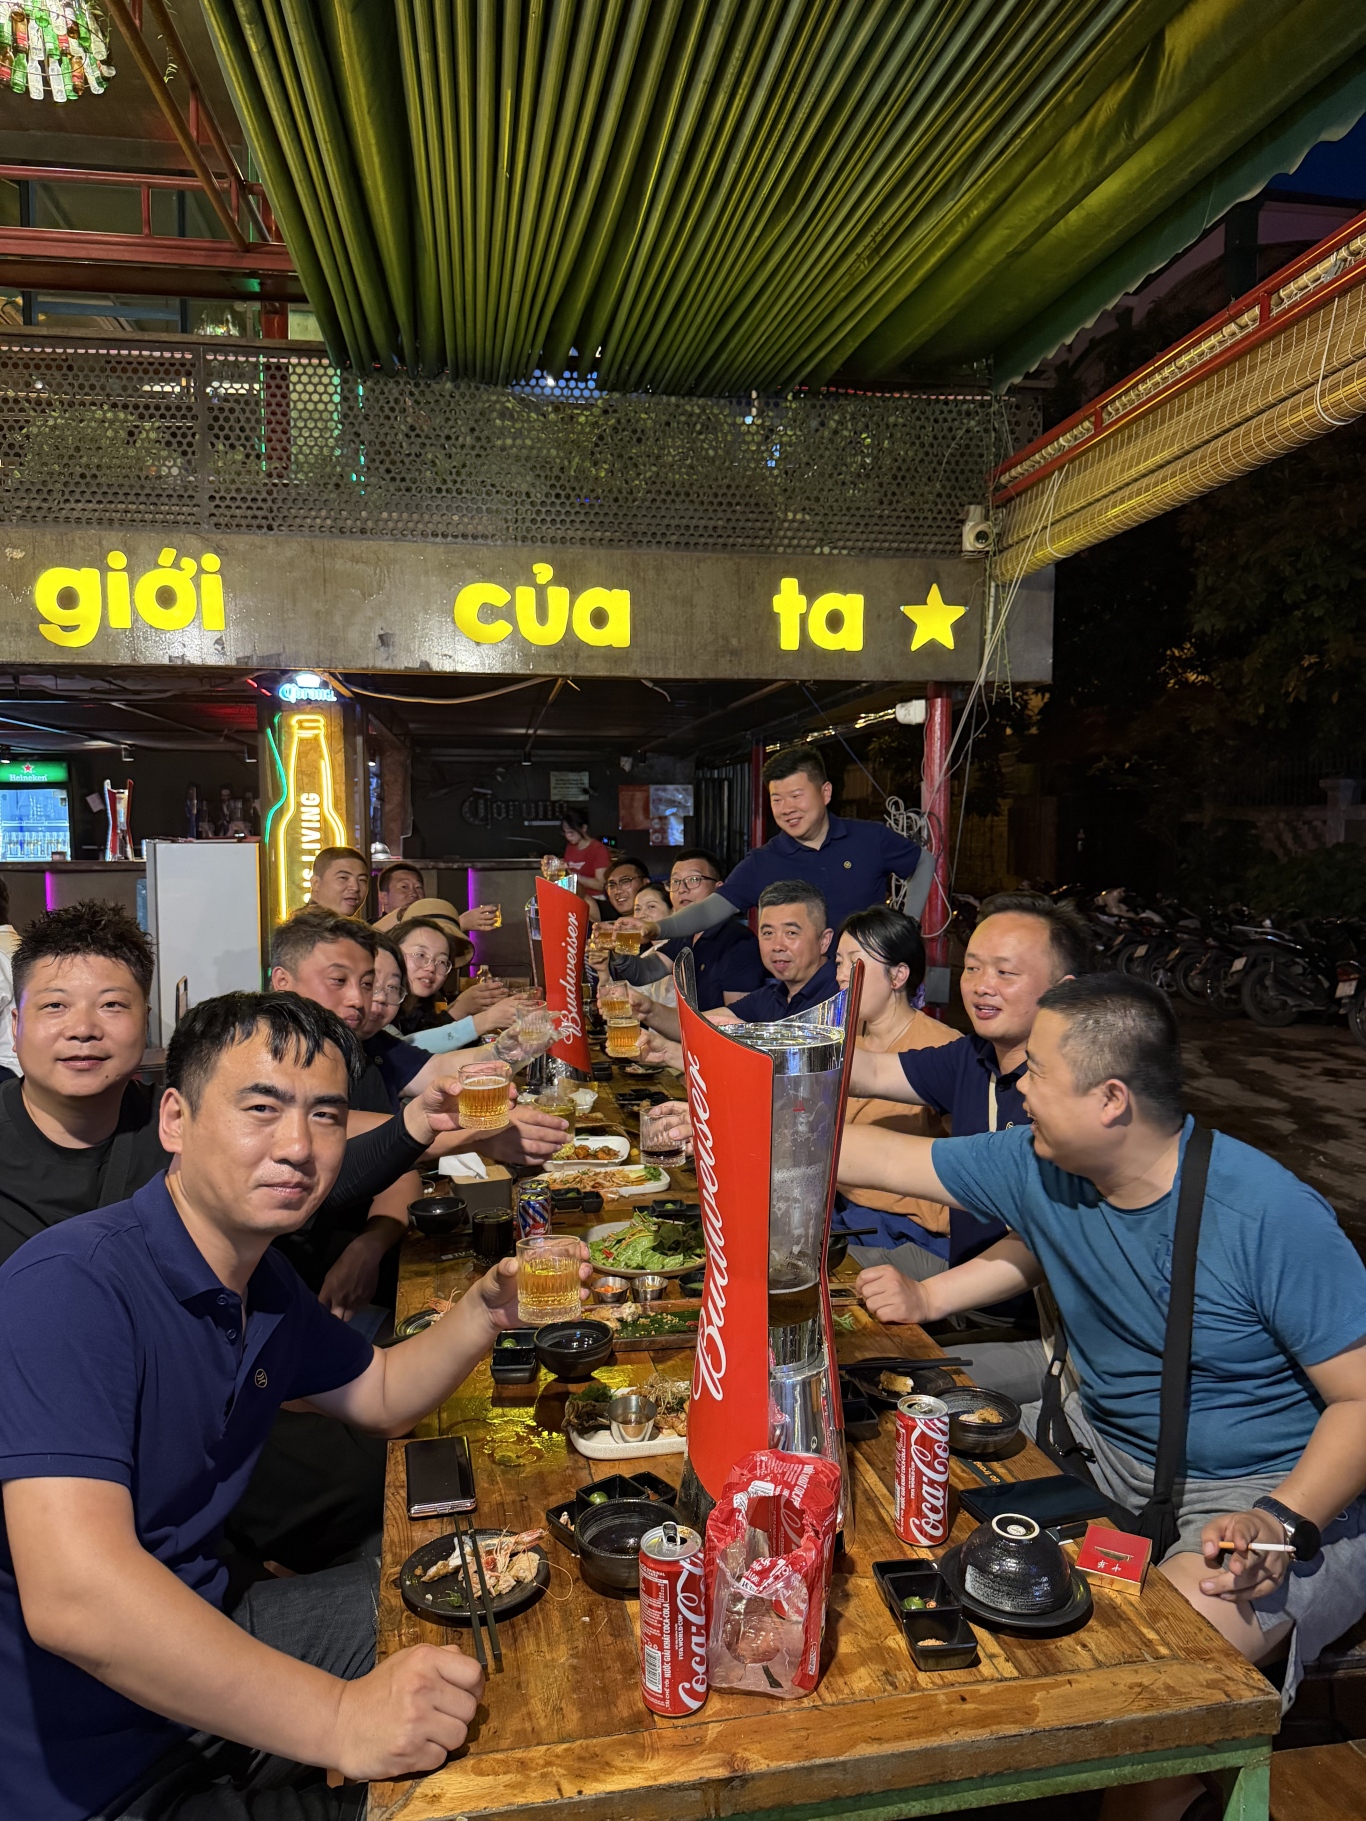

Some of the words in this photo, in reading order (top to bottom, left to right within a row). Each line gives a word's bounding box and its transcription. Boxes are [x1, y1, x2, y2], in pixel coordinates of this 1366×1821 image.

[35, 547, 226, 648] giới
[453, 562, 631, 648] của
[773, 577, 864, 652] ta
[278, 683, 338, 703] Corona
[9, 774, 48, 782] Heineken
[300, 792, 321, 862] LIVING
[559, 911, 582, 1045] Budweiser
[687, 1050, 728, 1401] Budweiser
[662, 1603, 671, 1634] COCA-COLA
